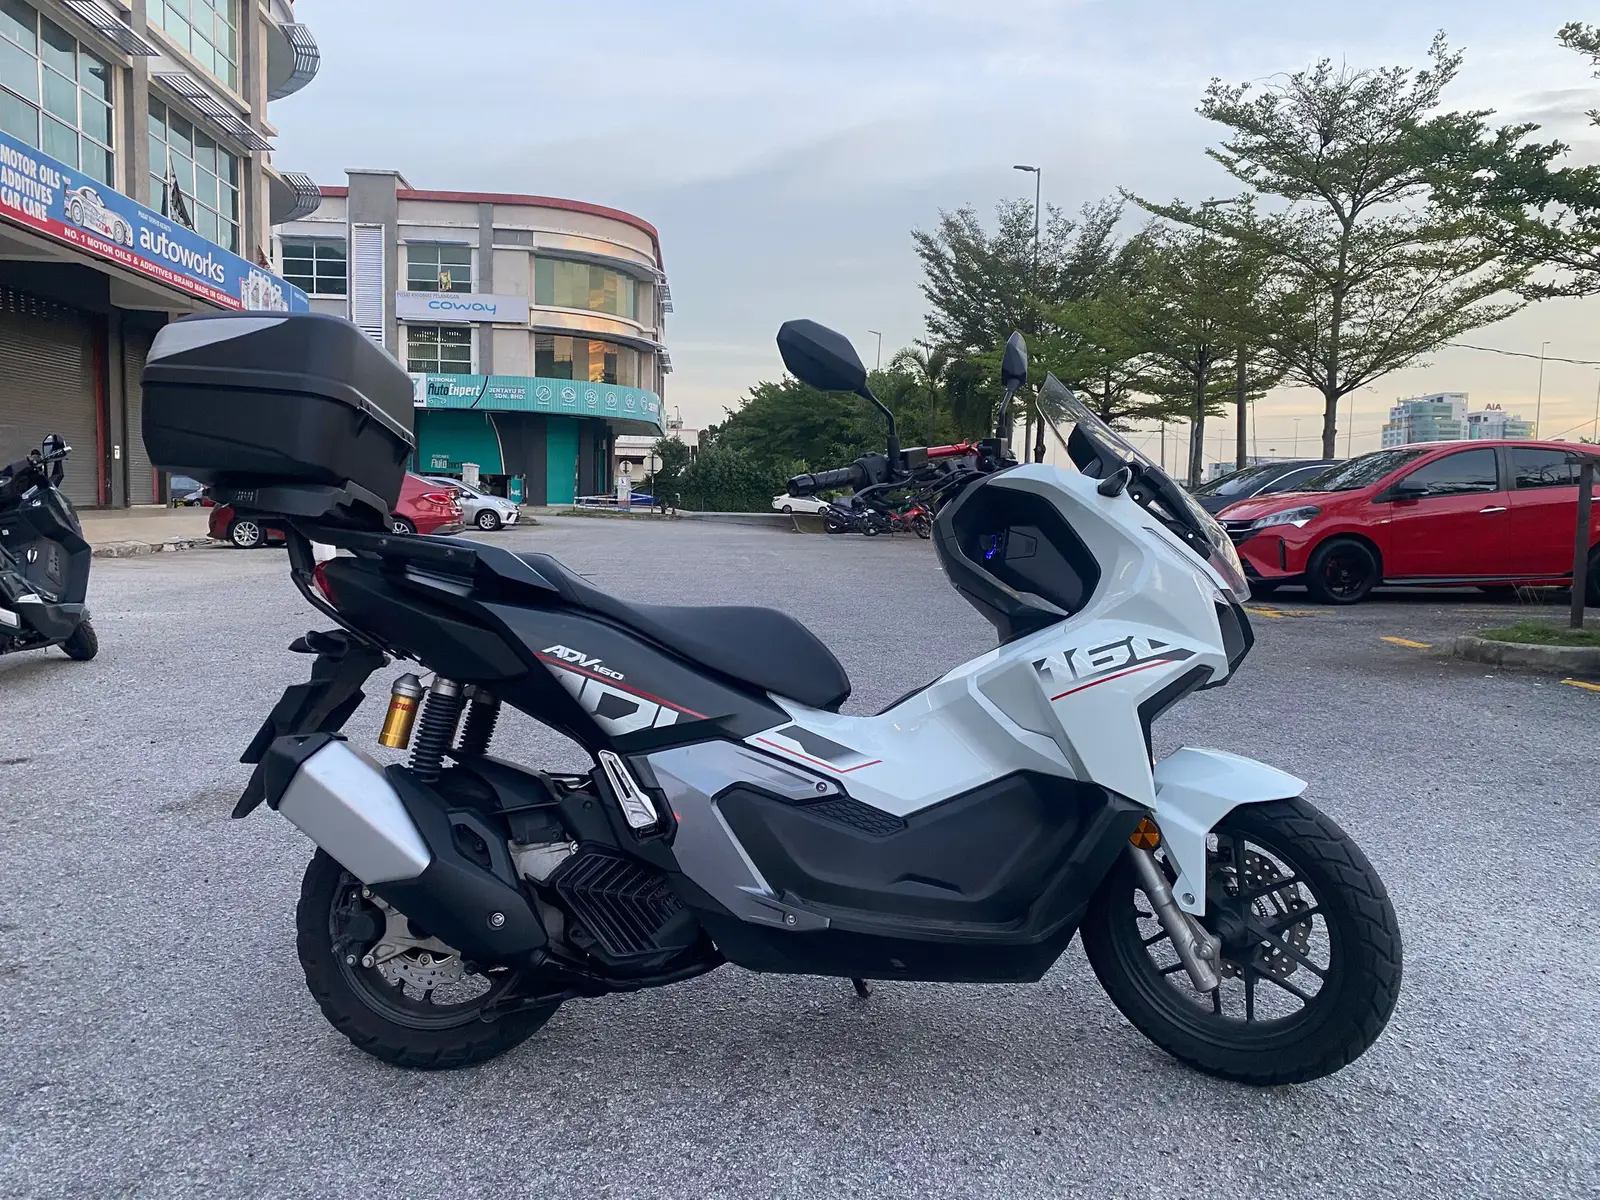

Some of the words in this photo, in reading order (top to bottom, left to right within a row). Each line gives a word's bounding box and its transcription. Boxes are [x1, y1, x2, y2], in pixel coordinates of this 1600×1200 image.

[0, 143, 37, 179] MOTOR
[39, 164, 61, 190] OILS
[0, 165, 53, 206] ADDITIVES
[0, 186, 21, 212] CAR
[22, 196, 48, 222] CARE
[64, 227, 79, 241] NO.
[81, 234, 86, 243] 1
[87, 237, 114, 256] MOTOR
[114, 249, 132, 263] OILS
[133, 256, 139, 265] &
[140, 260, 173, 281] ADDITIVES
[173, 274, 194, 289] BRAND
[194, 283, 209, 296] MADE
[210, 290, 216, 299] IN
[216, 292, 241, 308] GERMANY
[140, 227, 225, 284] autoworks
[428, 301, 497, 315] coway
[428, 383, 481, 398] AutoExpert
[1485, 403, 1502, 411] AIA
